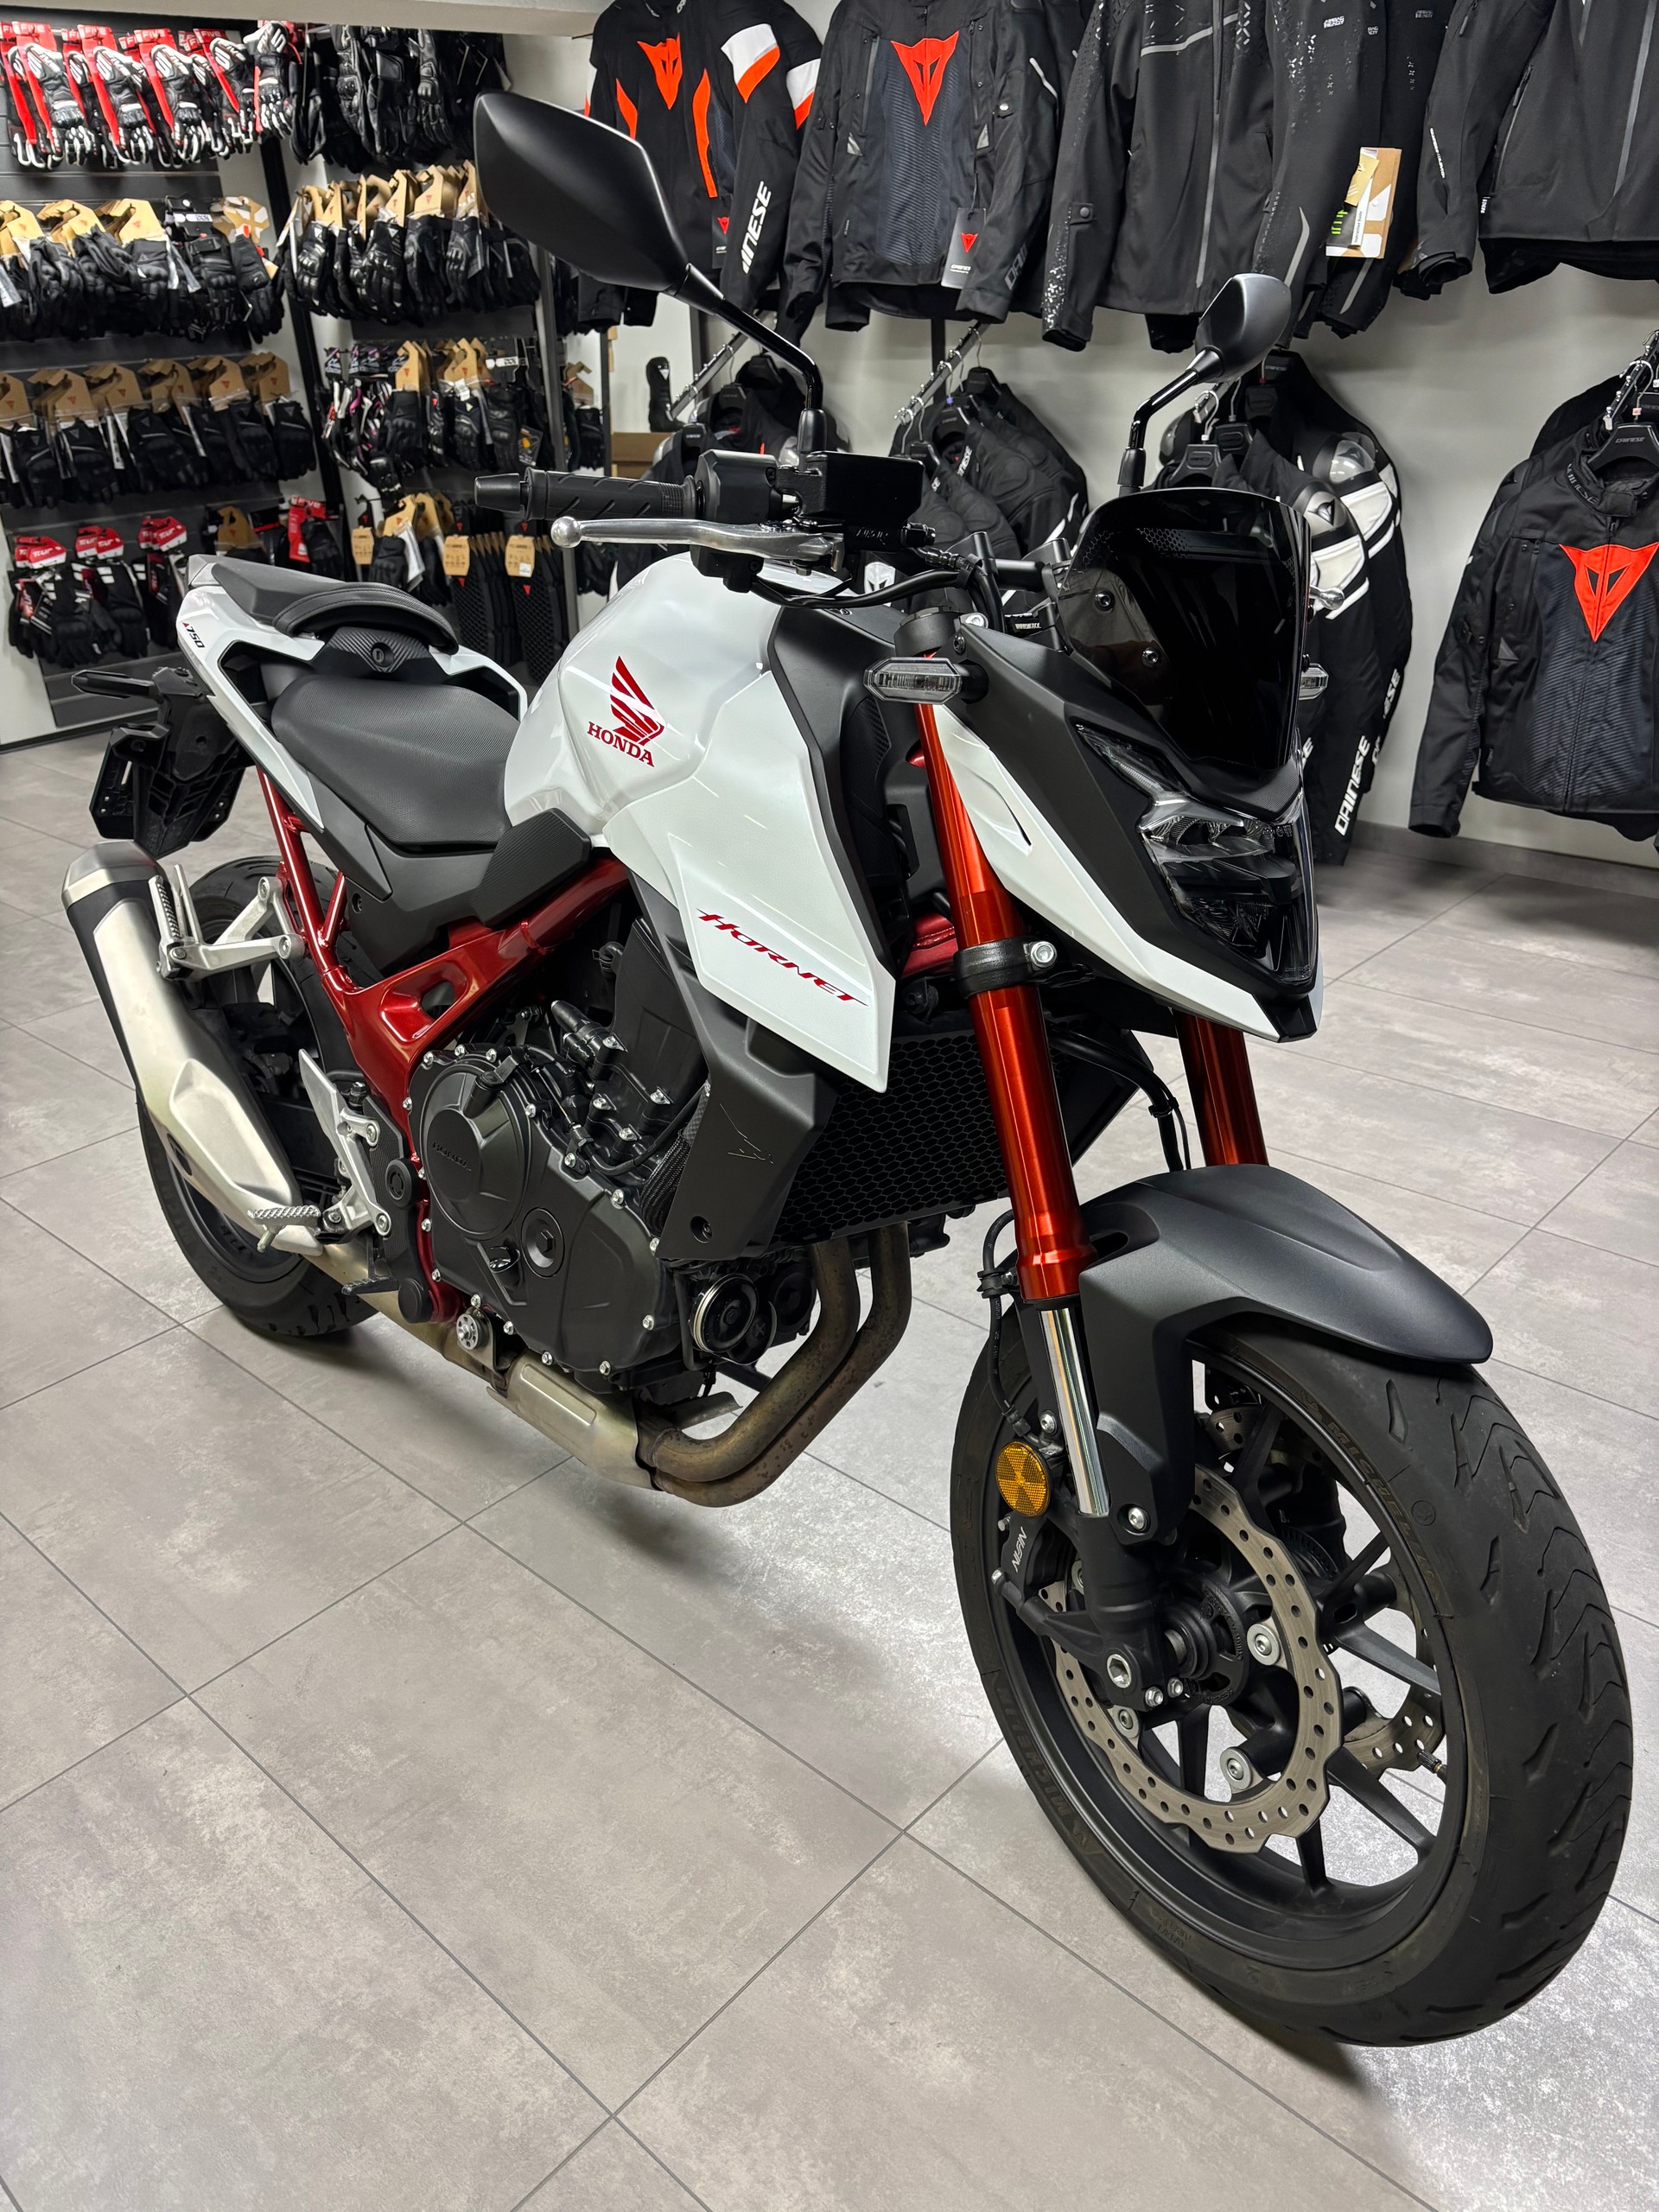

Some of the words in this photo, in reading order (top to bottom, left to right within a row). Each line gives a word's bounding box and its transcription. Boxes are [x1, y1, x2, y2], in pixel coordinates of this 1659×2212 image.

[142, 29, 166, 38] FIVE
[201, 29, 221, 38] FIVE
[186, 626, 206, 648] 750
[587, 721, 655, 768] HONDA
[1334, 734, 1371, 836] DAINESE
[1011, 1526, 1028, 1573] NISSIN
